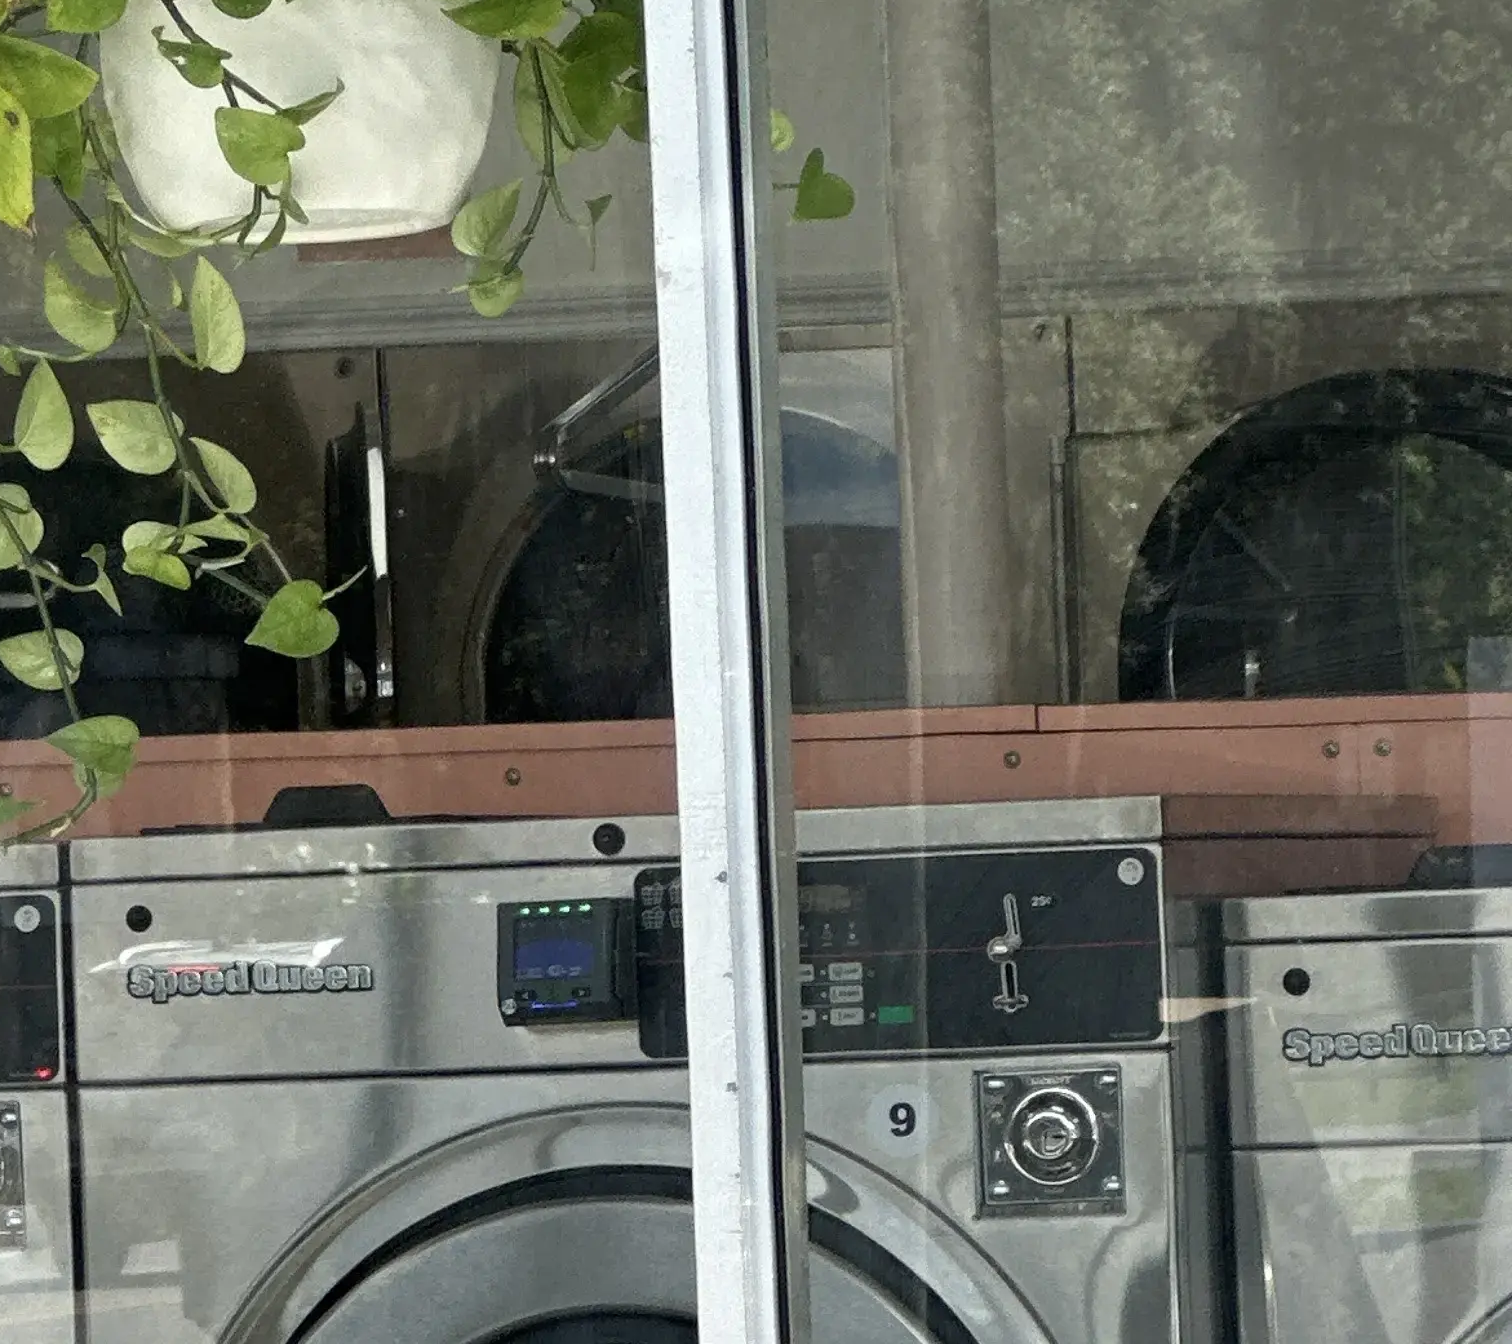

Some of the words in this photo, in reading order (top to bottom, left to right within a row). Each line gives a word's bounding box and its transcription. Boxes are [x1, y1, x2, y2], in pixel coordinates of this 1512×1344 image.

[128, 960, 250, 1004] Speed
[251, 959, 373, 993] Queen
[1282, 1023, 1409, 1067] Speed
[1409, 1021, 1512, 1057] Quee
[889, 1102, 916, 1137] 9
